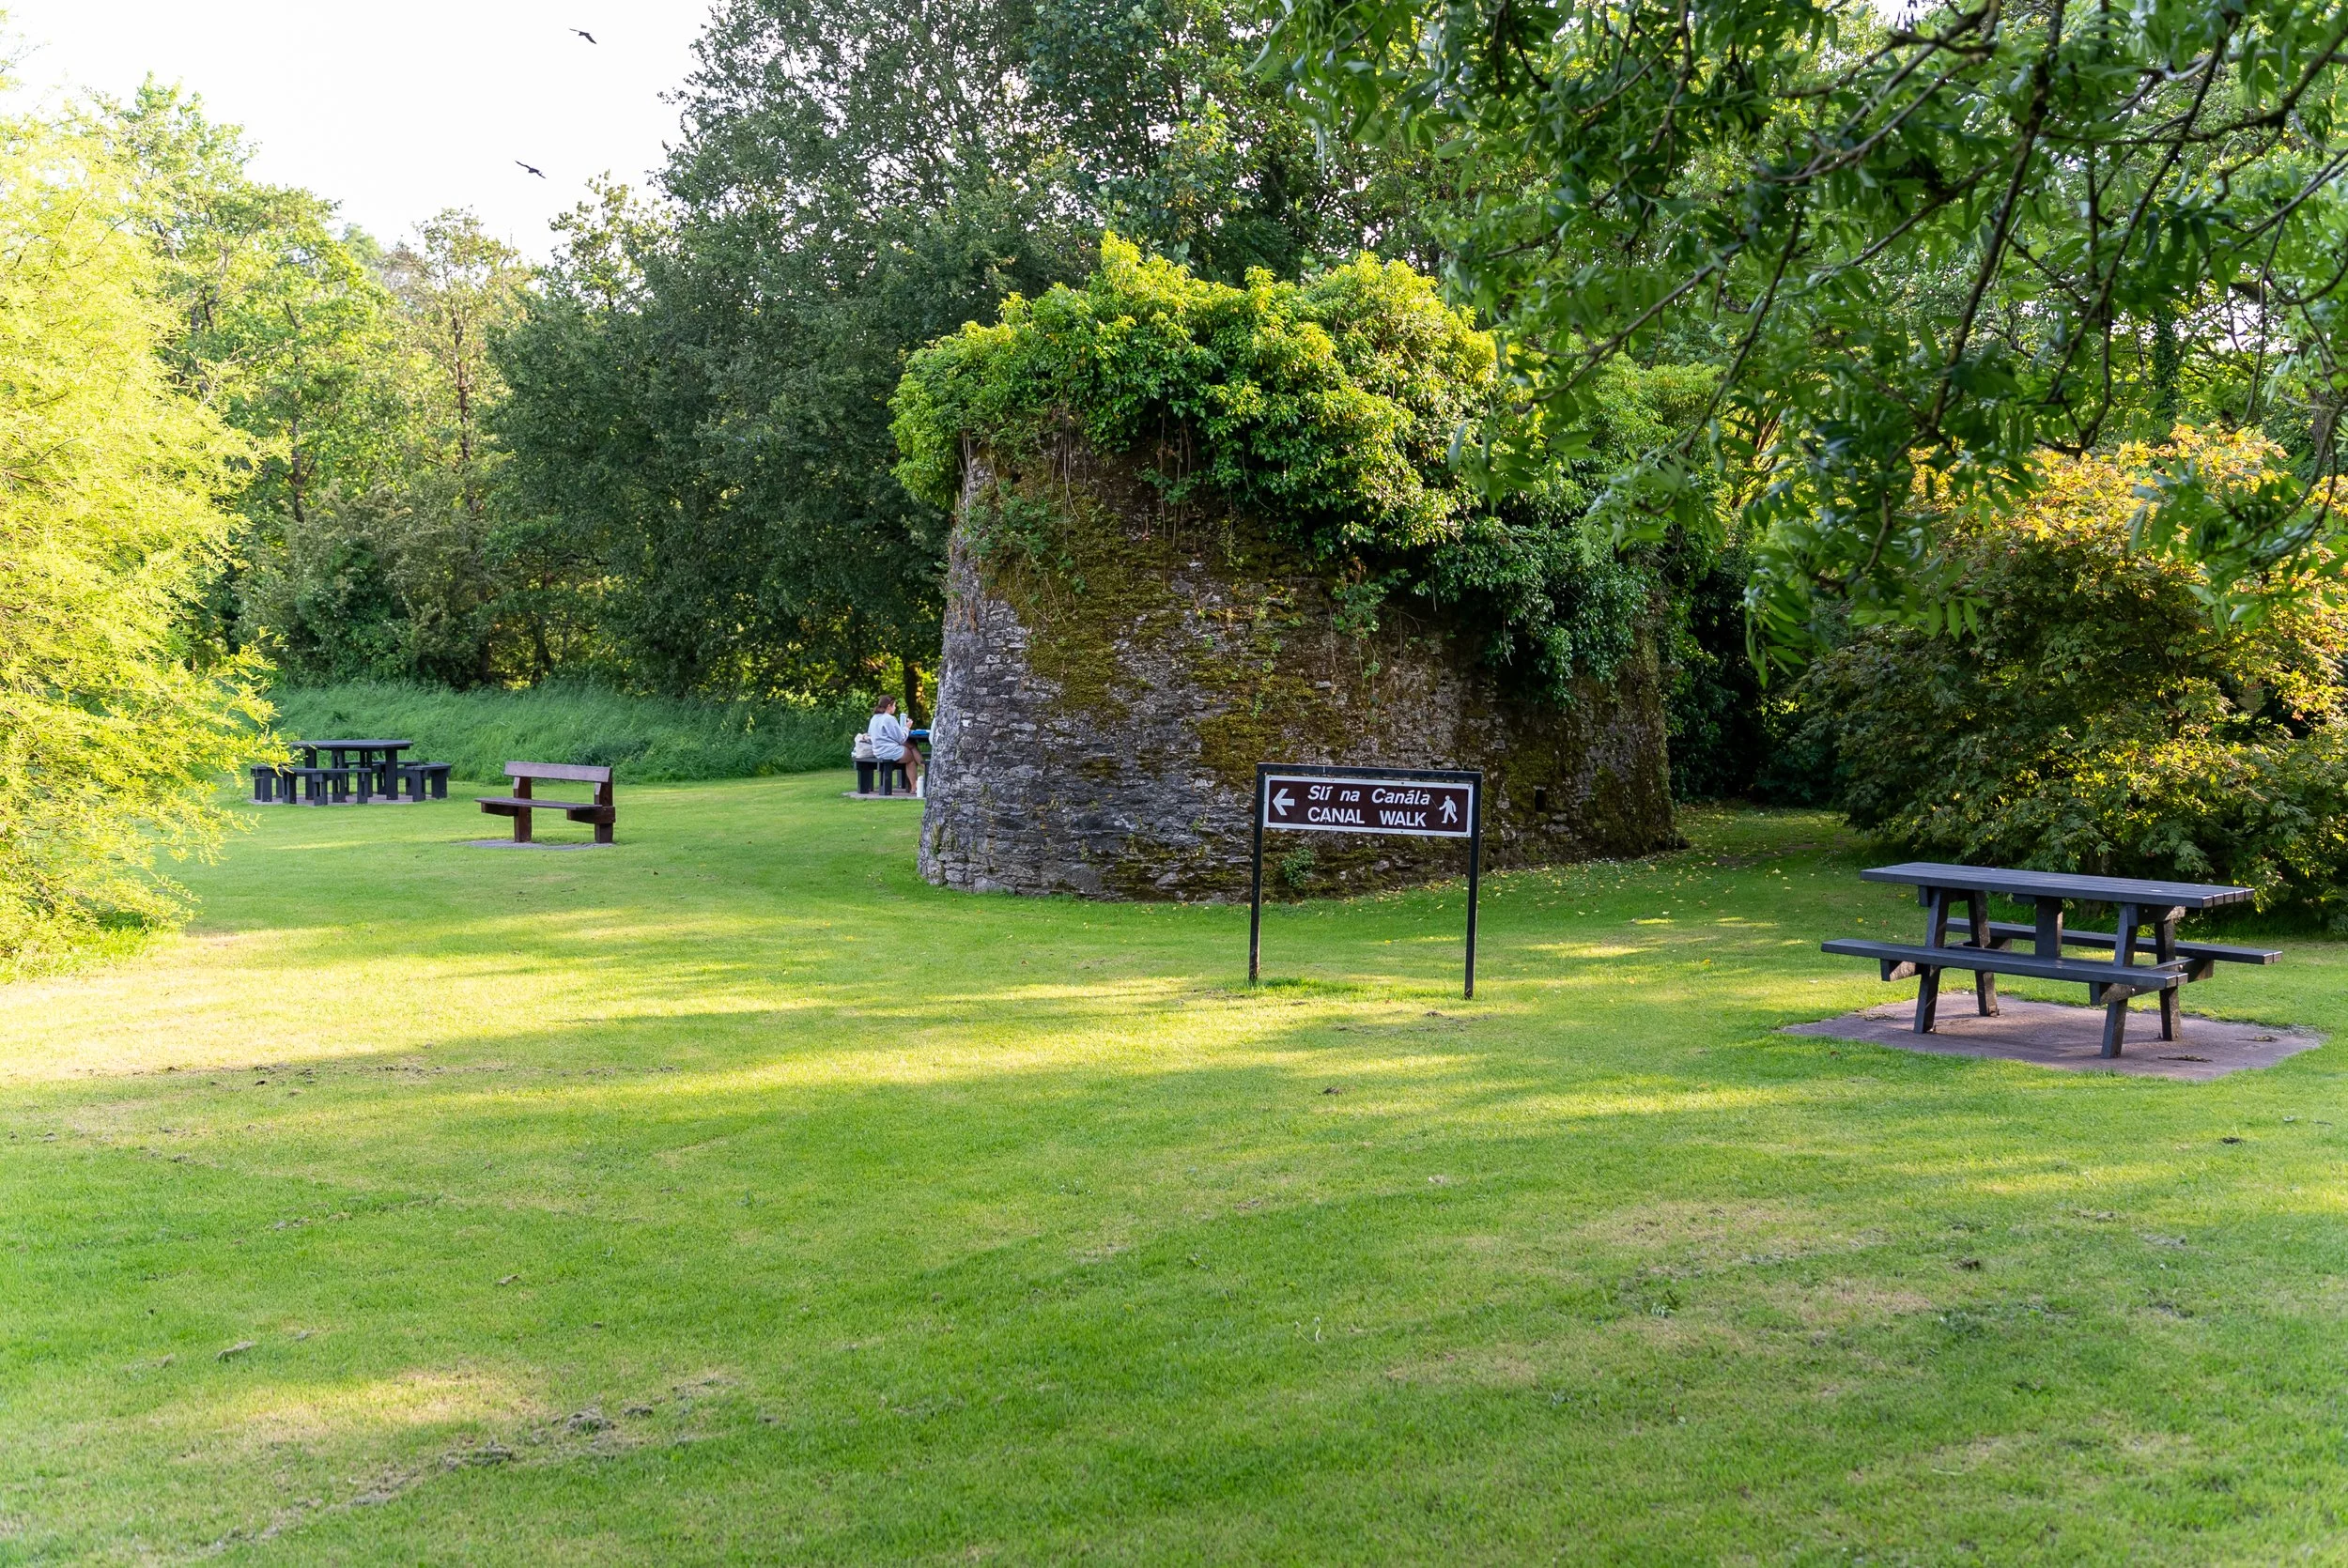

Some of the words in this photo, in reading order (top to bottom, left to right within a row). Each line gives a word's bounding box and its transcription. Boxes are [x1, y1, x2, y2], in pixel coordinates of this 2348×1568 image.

[1307, 785, 1334, 801] Slí
[1339, 790, 1361, 802] na
[1371, 788, 1430, 806] Canála
[1307, 807, 1366, 824] CANAL
[1380, 810, 1427, 827] WALK
